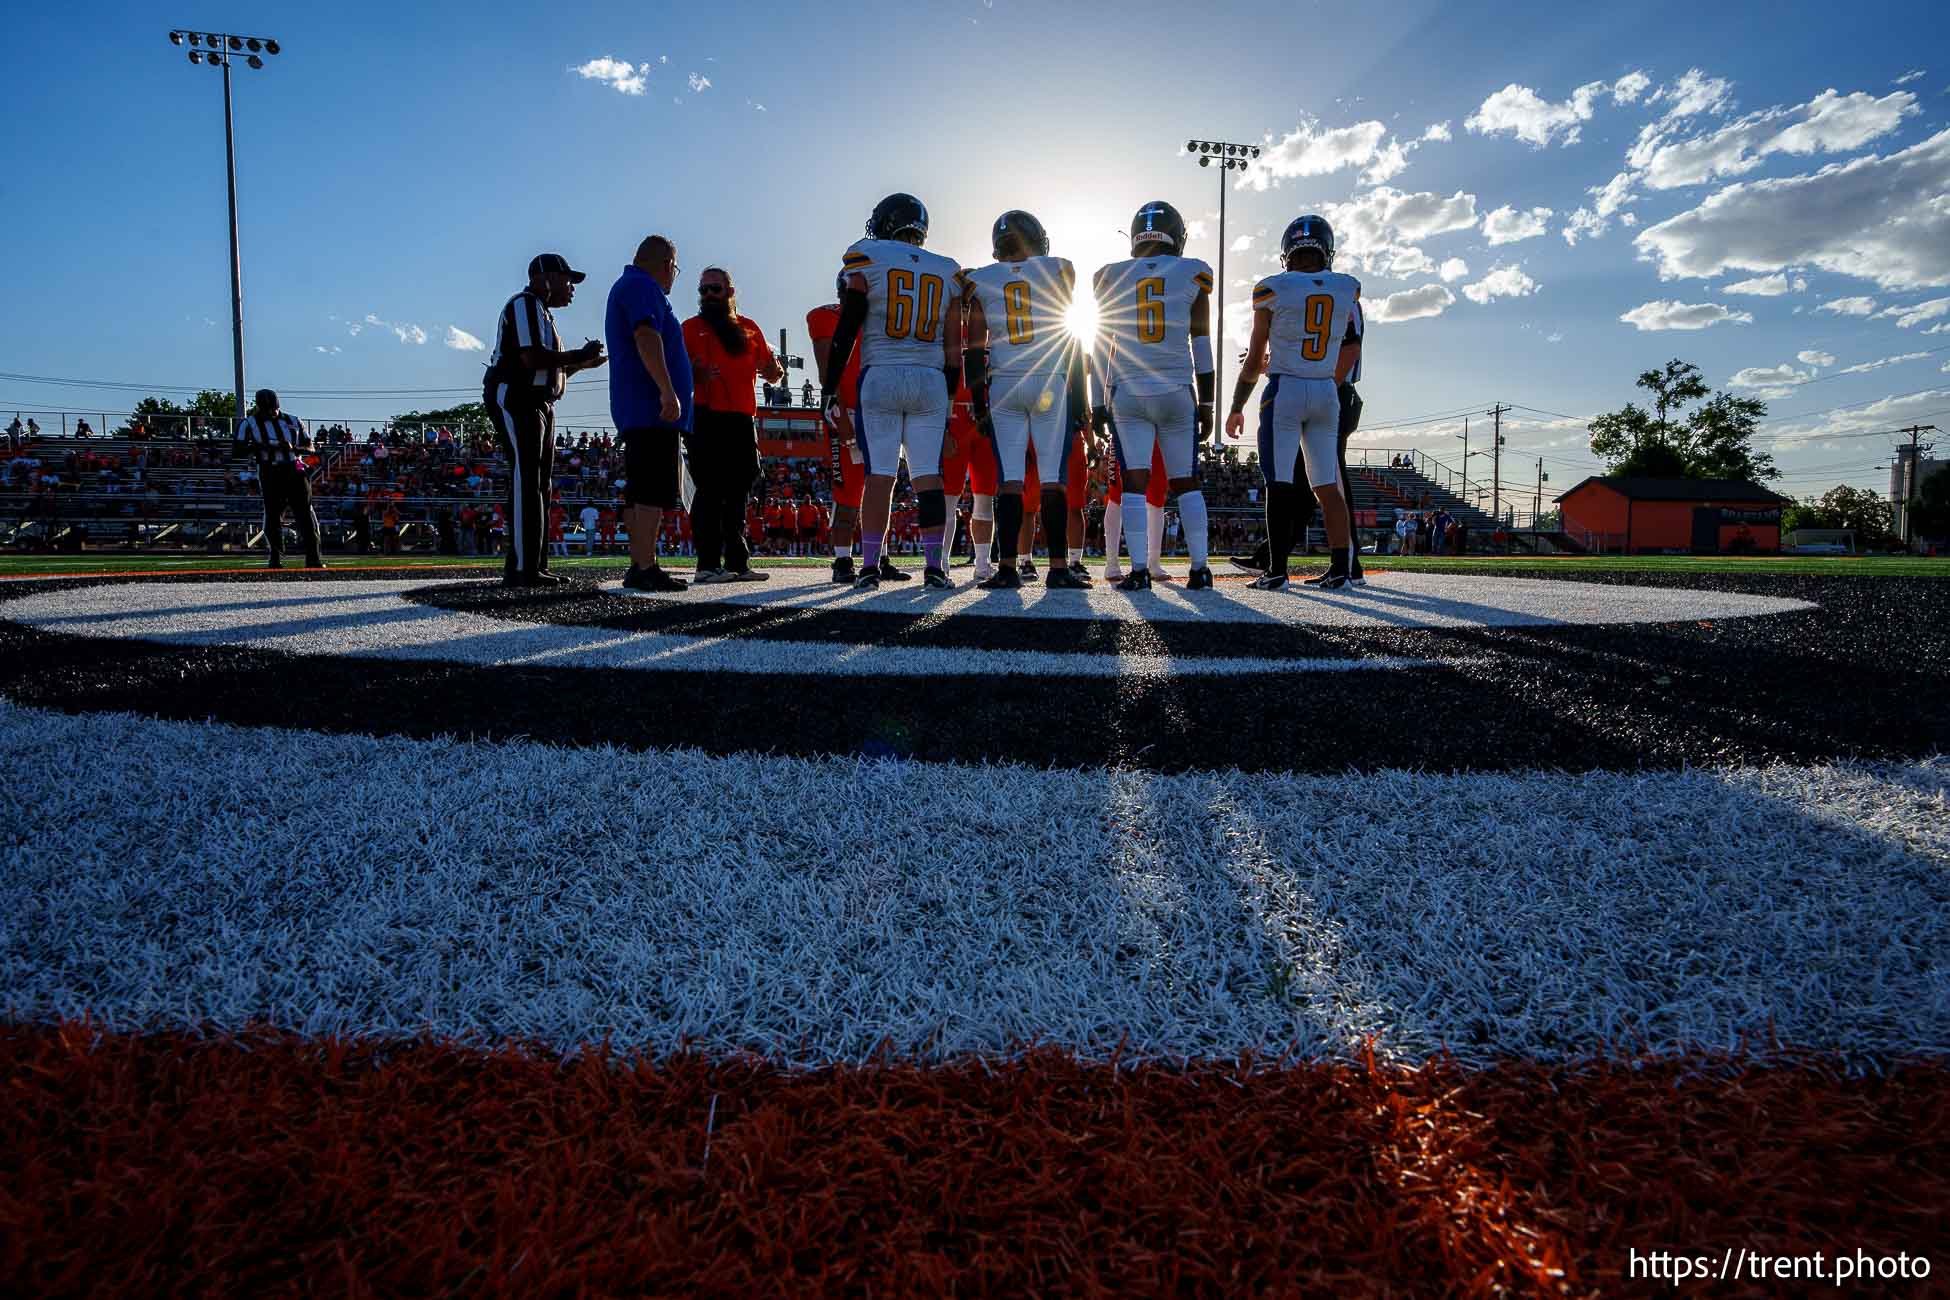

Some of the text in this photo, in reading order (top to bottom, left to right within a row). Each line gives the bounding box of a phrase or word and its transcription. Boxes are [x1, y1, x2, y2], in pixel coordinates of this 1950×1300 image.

[885, 268, 944, 342] 60
[1003, 280, 1034, 344] 8
[1136, 277, 1166, 344] 6
[1301, 294, 1334, 361] 9
[831, 438, 843, 482] MURRAY
